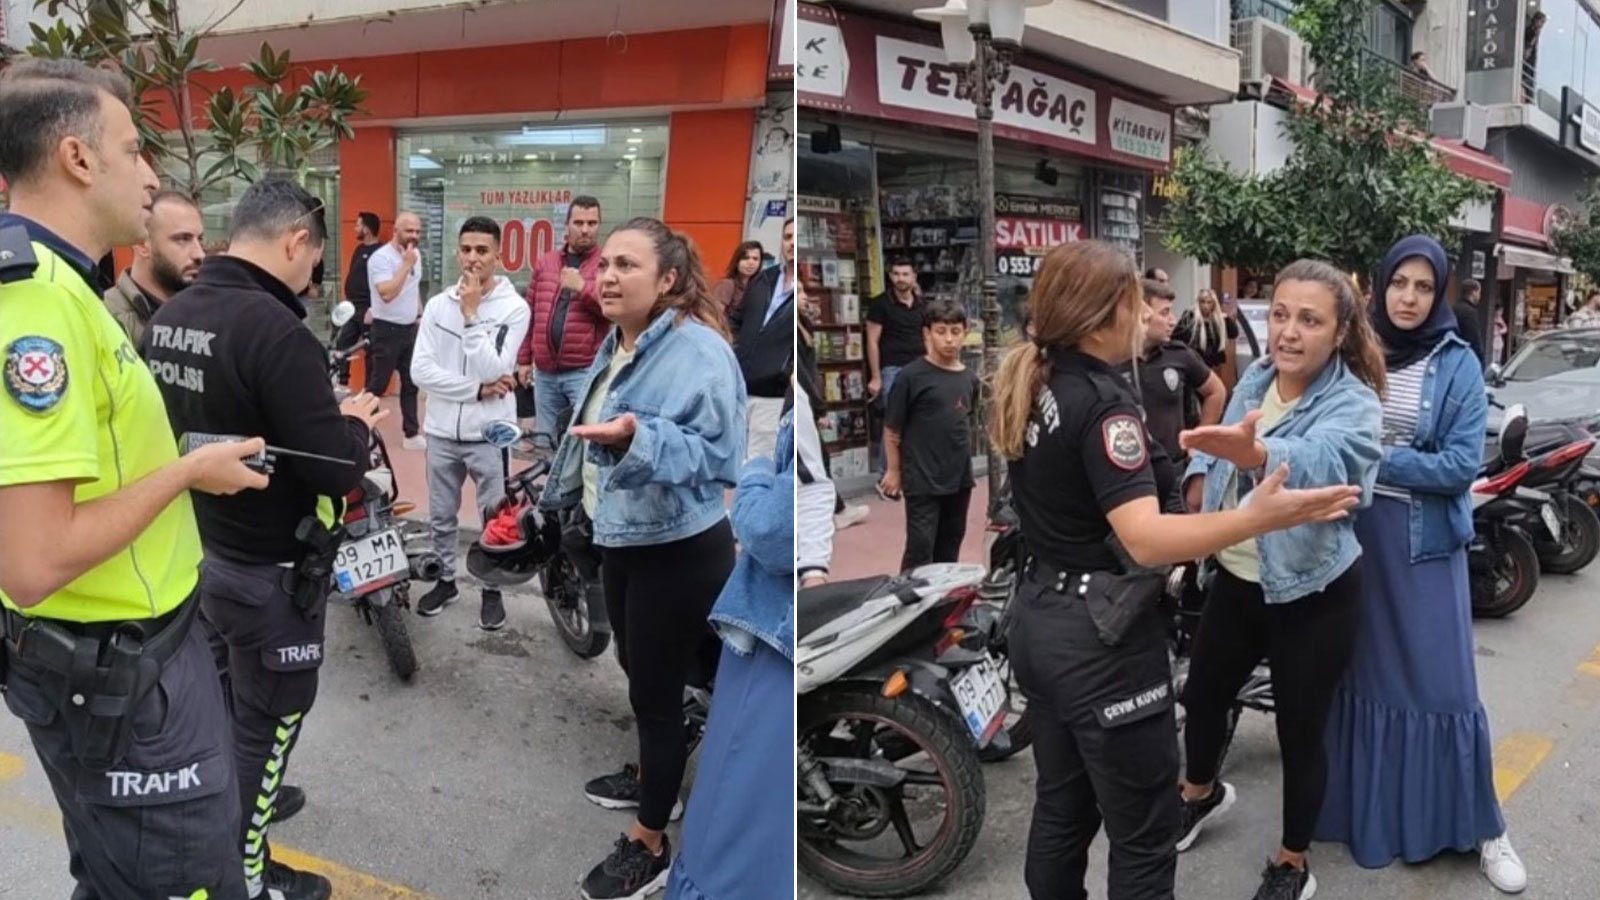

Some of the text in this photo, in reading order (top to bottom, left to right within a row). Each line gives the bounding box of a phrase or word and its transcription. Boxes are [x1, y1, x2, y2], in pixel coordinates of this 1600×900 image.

[508, 190, 572, 205] YAZLIKLAR
[995, 219, 1081, 247] SATILIK
[998, 256, 1009, 273] 0
[1009, 256, 1031, 274] 553
[336, 534, 397, 567] 09 MA
[354, 554, 394, 581] 1277
